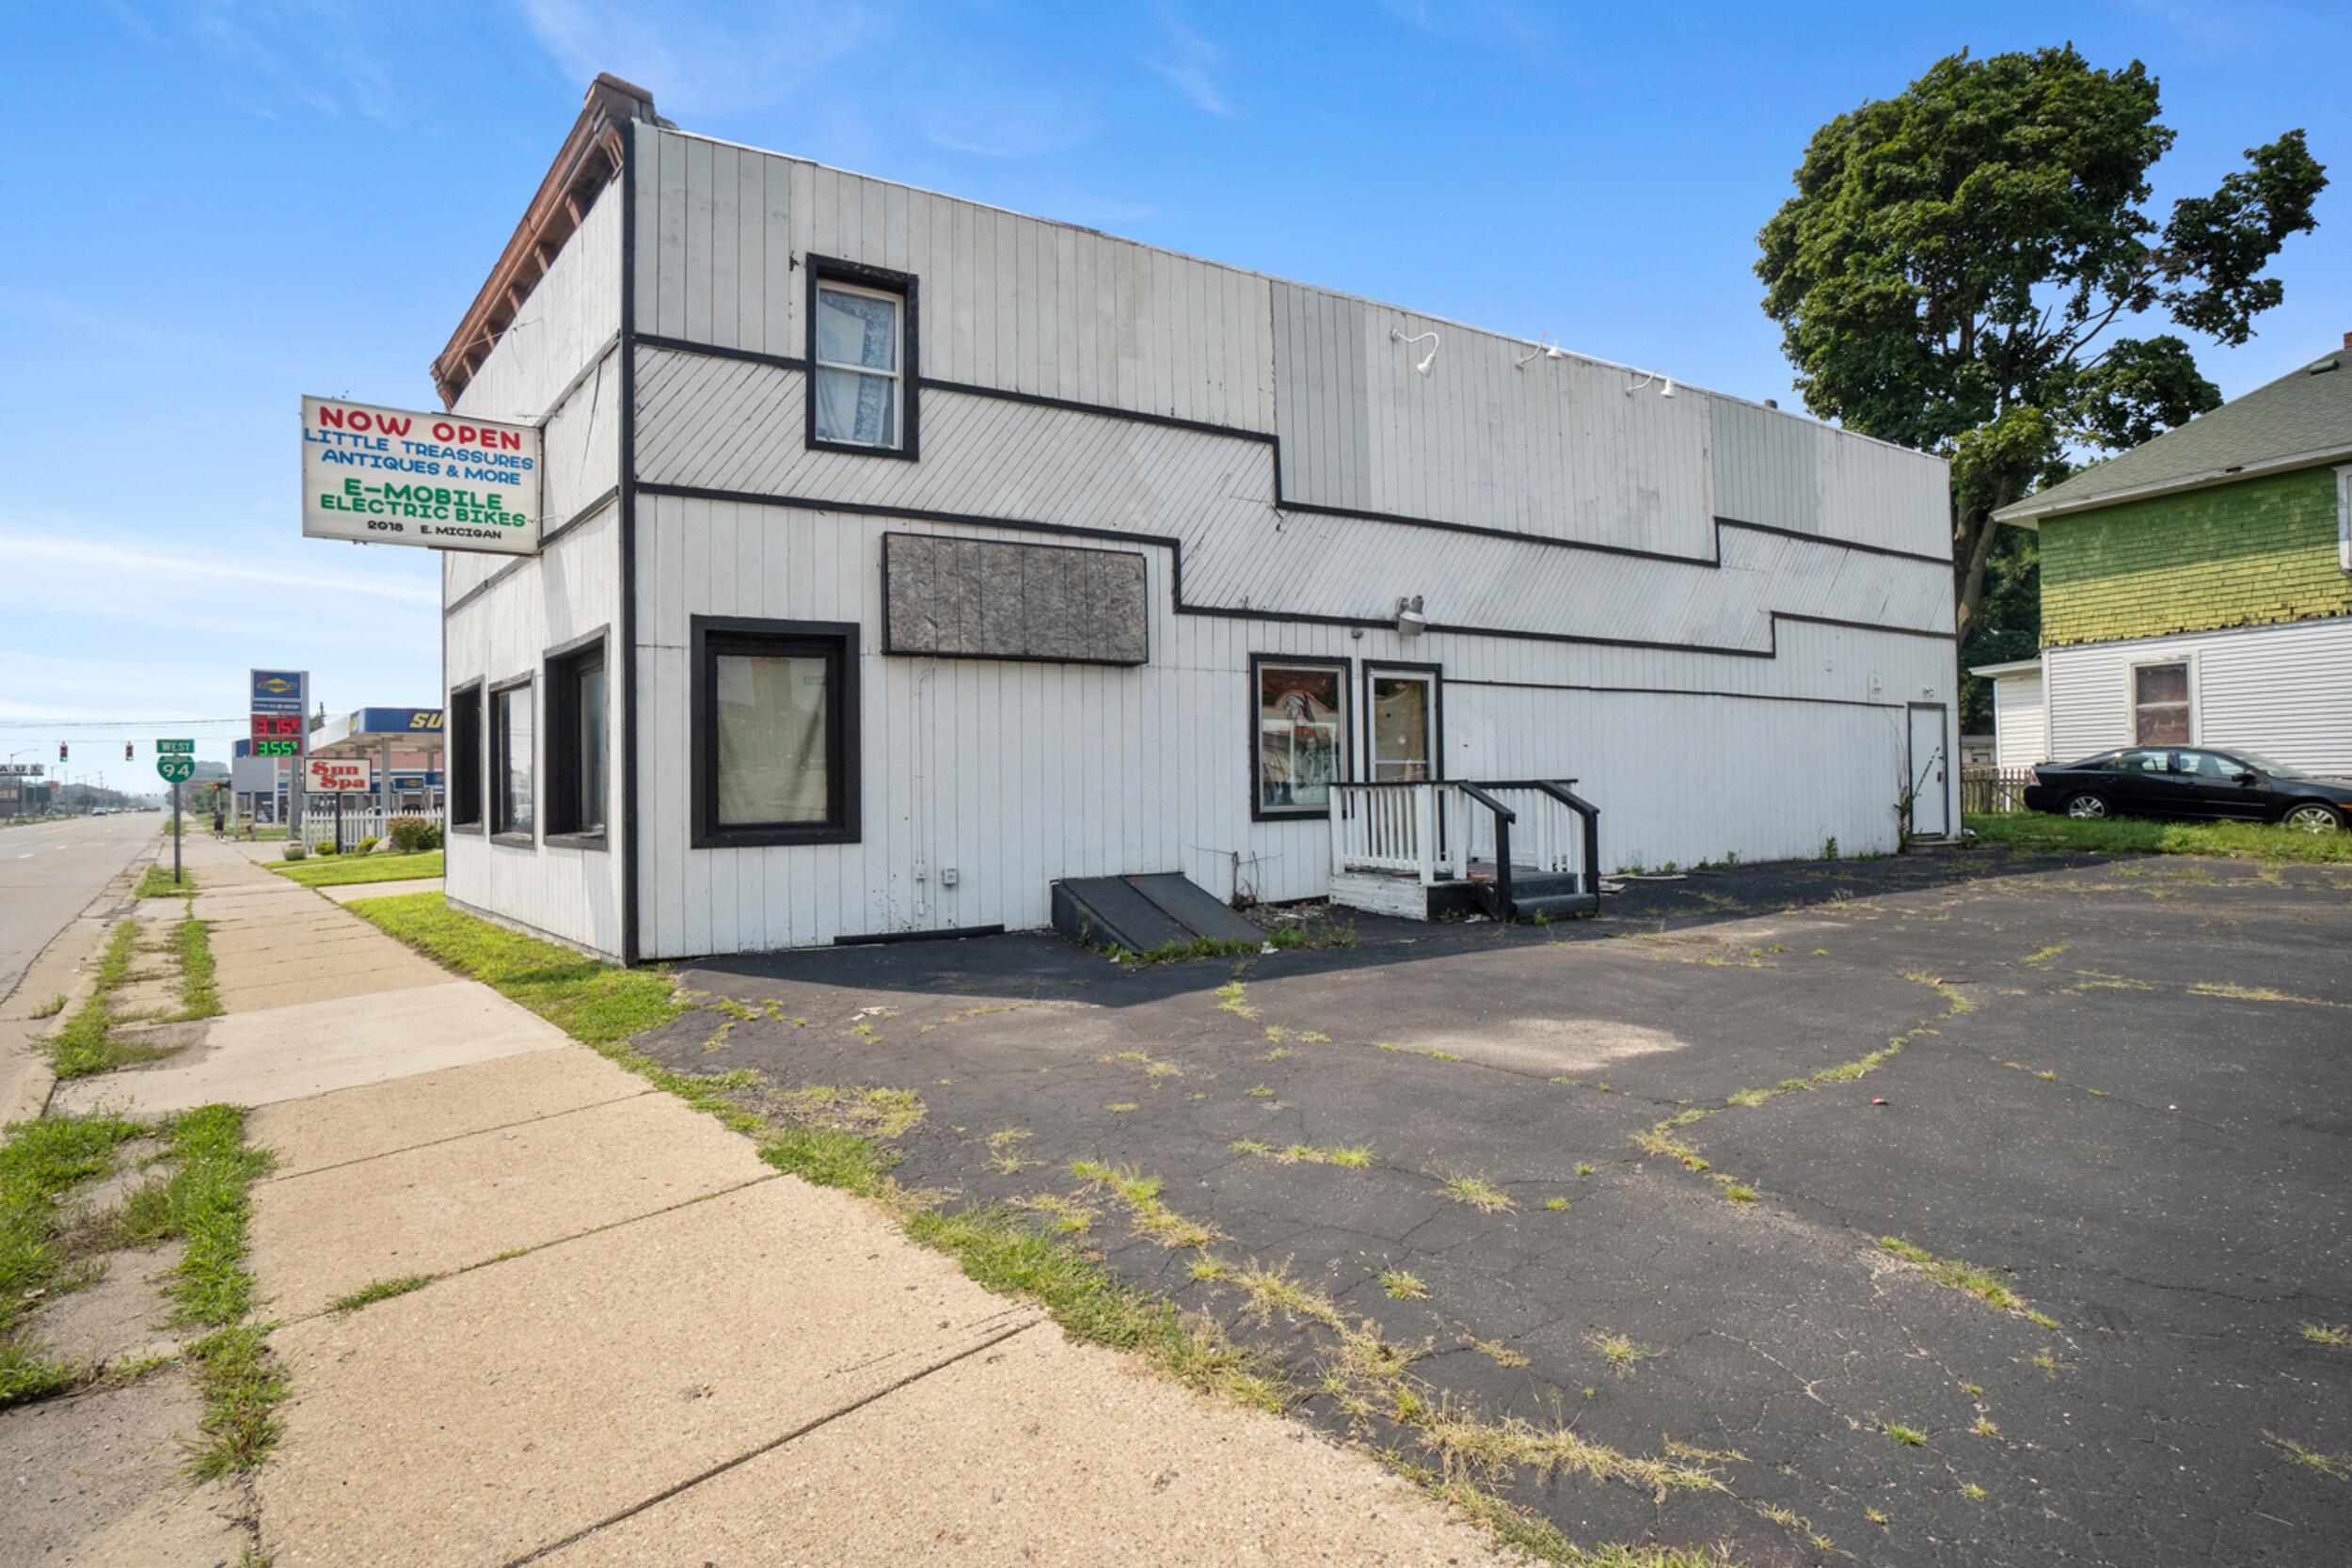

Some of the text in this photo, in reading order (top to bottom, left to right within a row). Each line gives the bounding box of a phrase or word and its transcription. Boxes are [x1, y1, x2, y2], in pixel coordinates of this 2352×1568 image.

[319, 405, 521, 451] NOW OPEN
[304, 427, 533, 470] LITTLE TREASSURES
[322, 449, 521, 485] ANTIQUES & MORE
[344, 478, 502, 511] E-MOBILE
[321, 494, 526, 528] ELECTRIC BIKES
[368, 520, 501, 539] 2018 E. MICIGAN
[162, 741, 190, 752] WEST
[163, 764, 190, 777] 94
[310, 761, 358, 776] Sun
[320, 775, 365, 790] Spa
